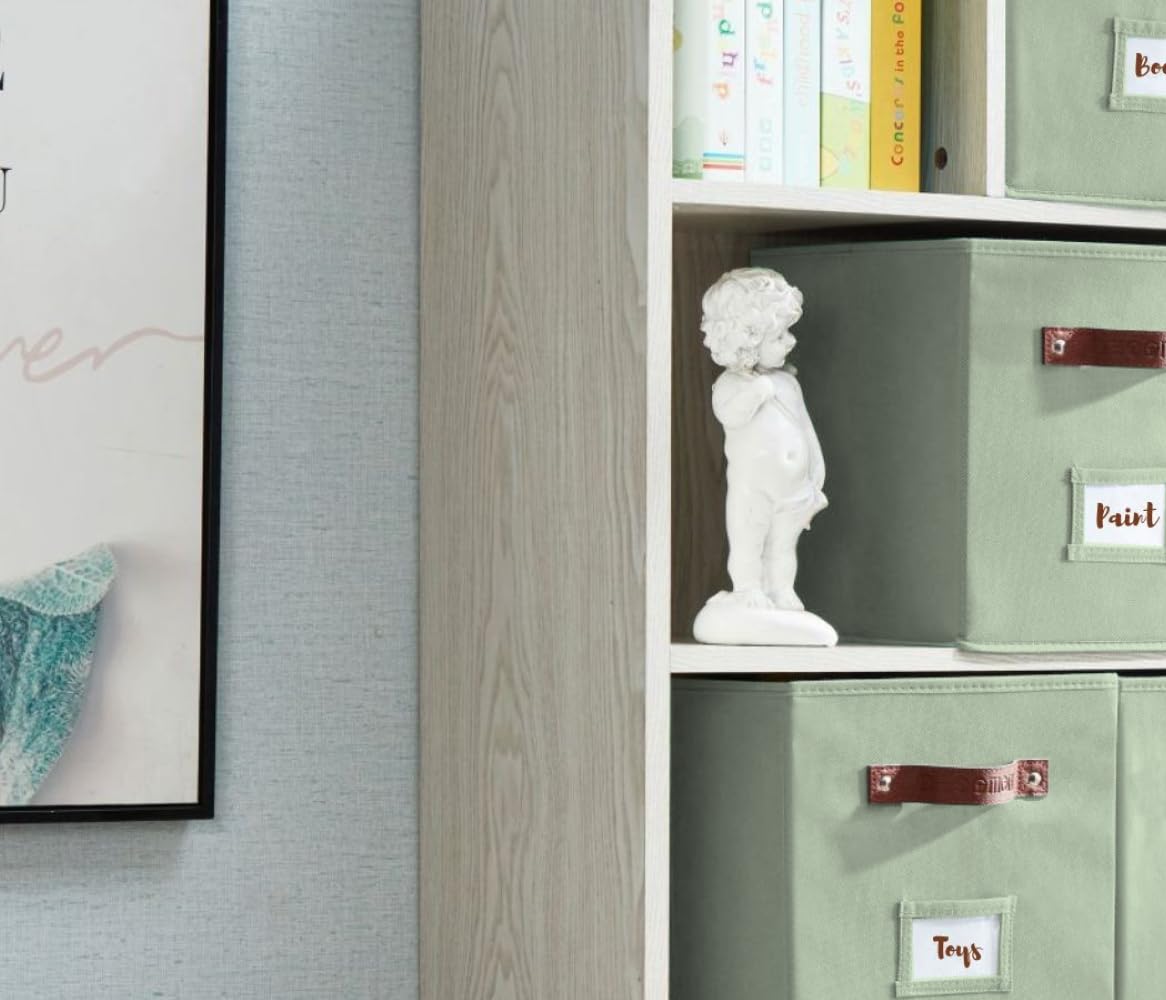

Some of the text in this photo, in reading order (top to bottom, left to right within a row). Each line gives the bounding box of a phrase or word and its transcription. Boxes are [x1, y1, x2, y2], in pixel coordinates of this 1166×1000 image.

[895, 60, 904, 72] in
[1096, 502, 1160, 529] Paint
[933, 936, 983, 968] Toys
